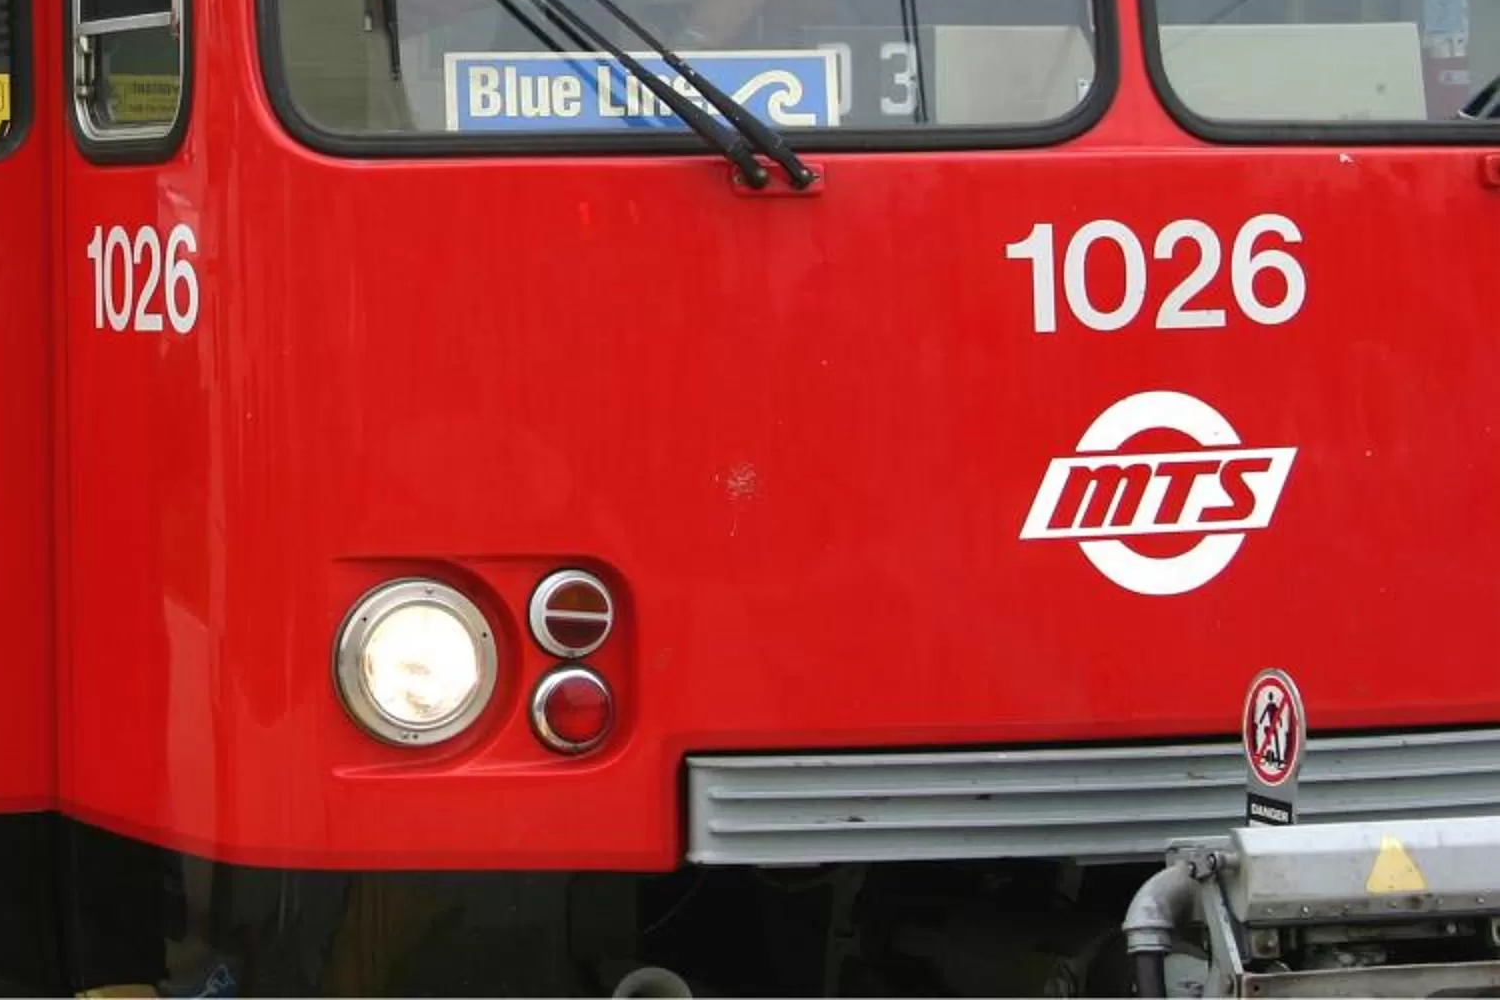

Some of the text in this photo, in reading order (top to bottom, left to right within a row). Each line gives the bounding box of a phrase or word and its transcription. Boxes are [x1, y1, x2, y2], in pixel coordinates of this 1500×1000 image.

[468, 64, 581, 118] Blue
[880, 42, 917, 115] 3
[87, 224, 199, 334] 1026
[1006, 213, 1307, 333] 1026
[1045, 457, 1274, 532] MTS
